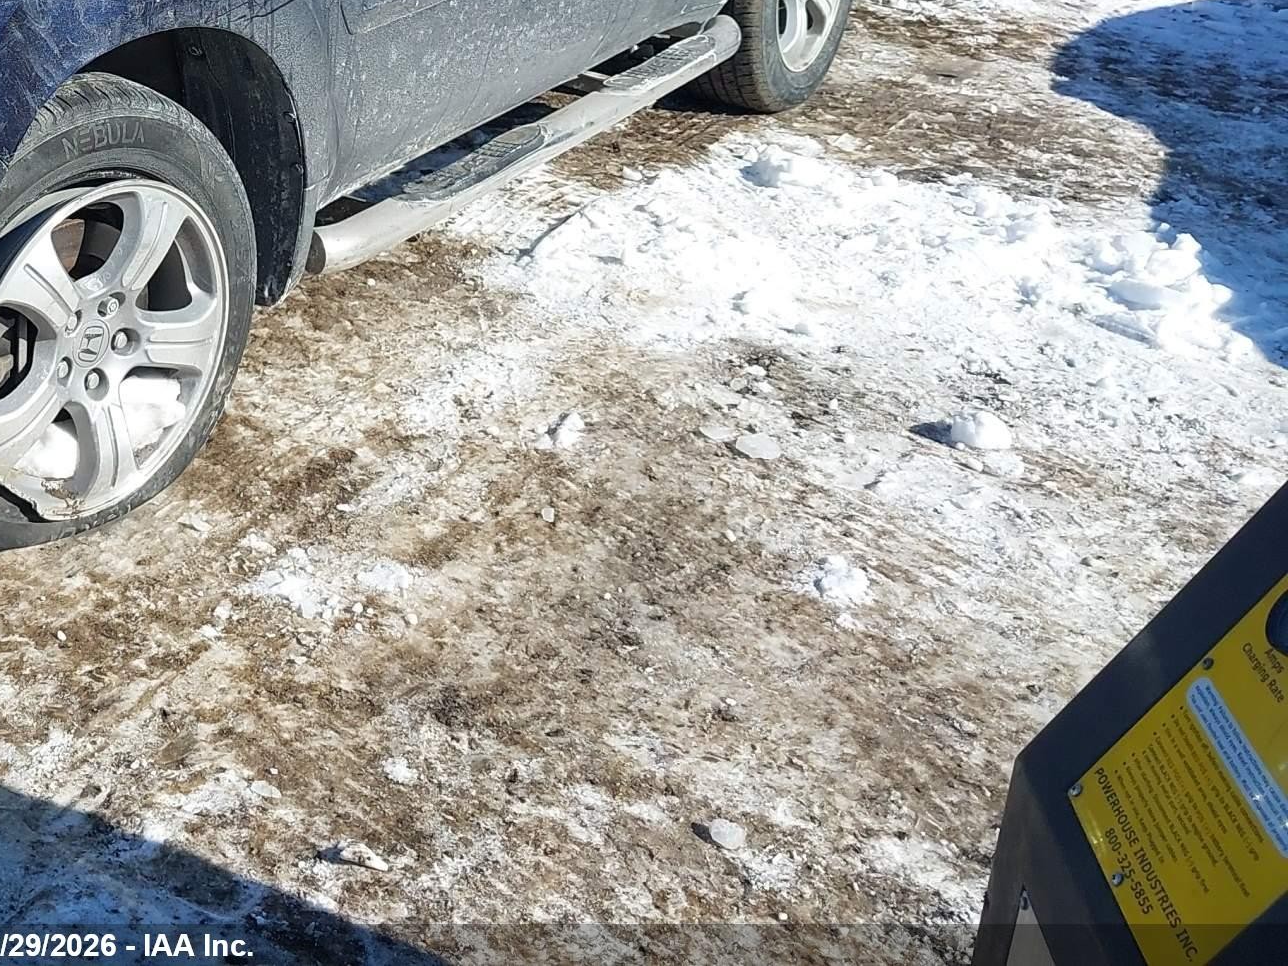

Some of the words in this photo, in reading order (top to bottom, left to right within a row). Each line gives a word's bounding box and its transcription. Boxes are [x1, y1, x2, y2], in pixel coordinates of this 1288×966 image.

[61, 121, 145, 160] NEBULA
[1242, 642, 1270, 683] Charging
[1266, 679, 1285, 703] Rate
[1264, 648, 1285, 674] Amps
[1092, 767, 1140, 847] POWERHOUSE
[1132, 846, 1182, 929] INDUSTRIES
[1174, 929, 1200, 962] INC.
[1102, 826, 1154, 915] 800-325-5855
